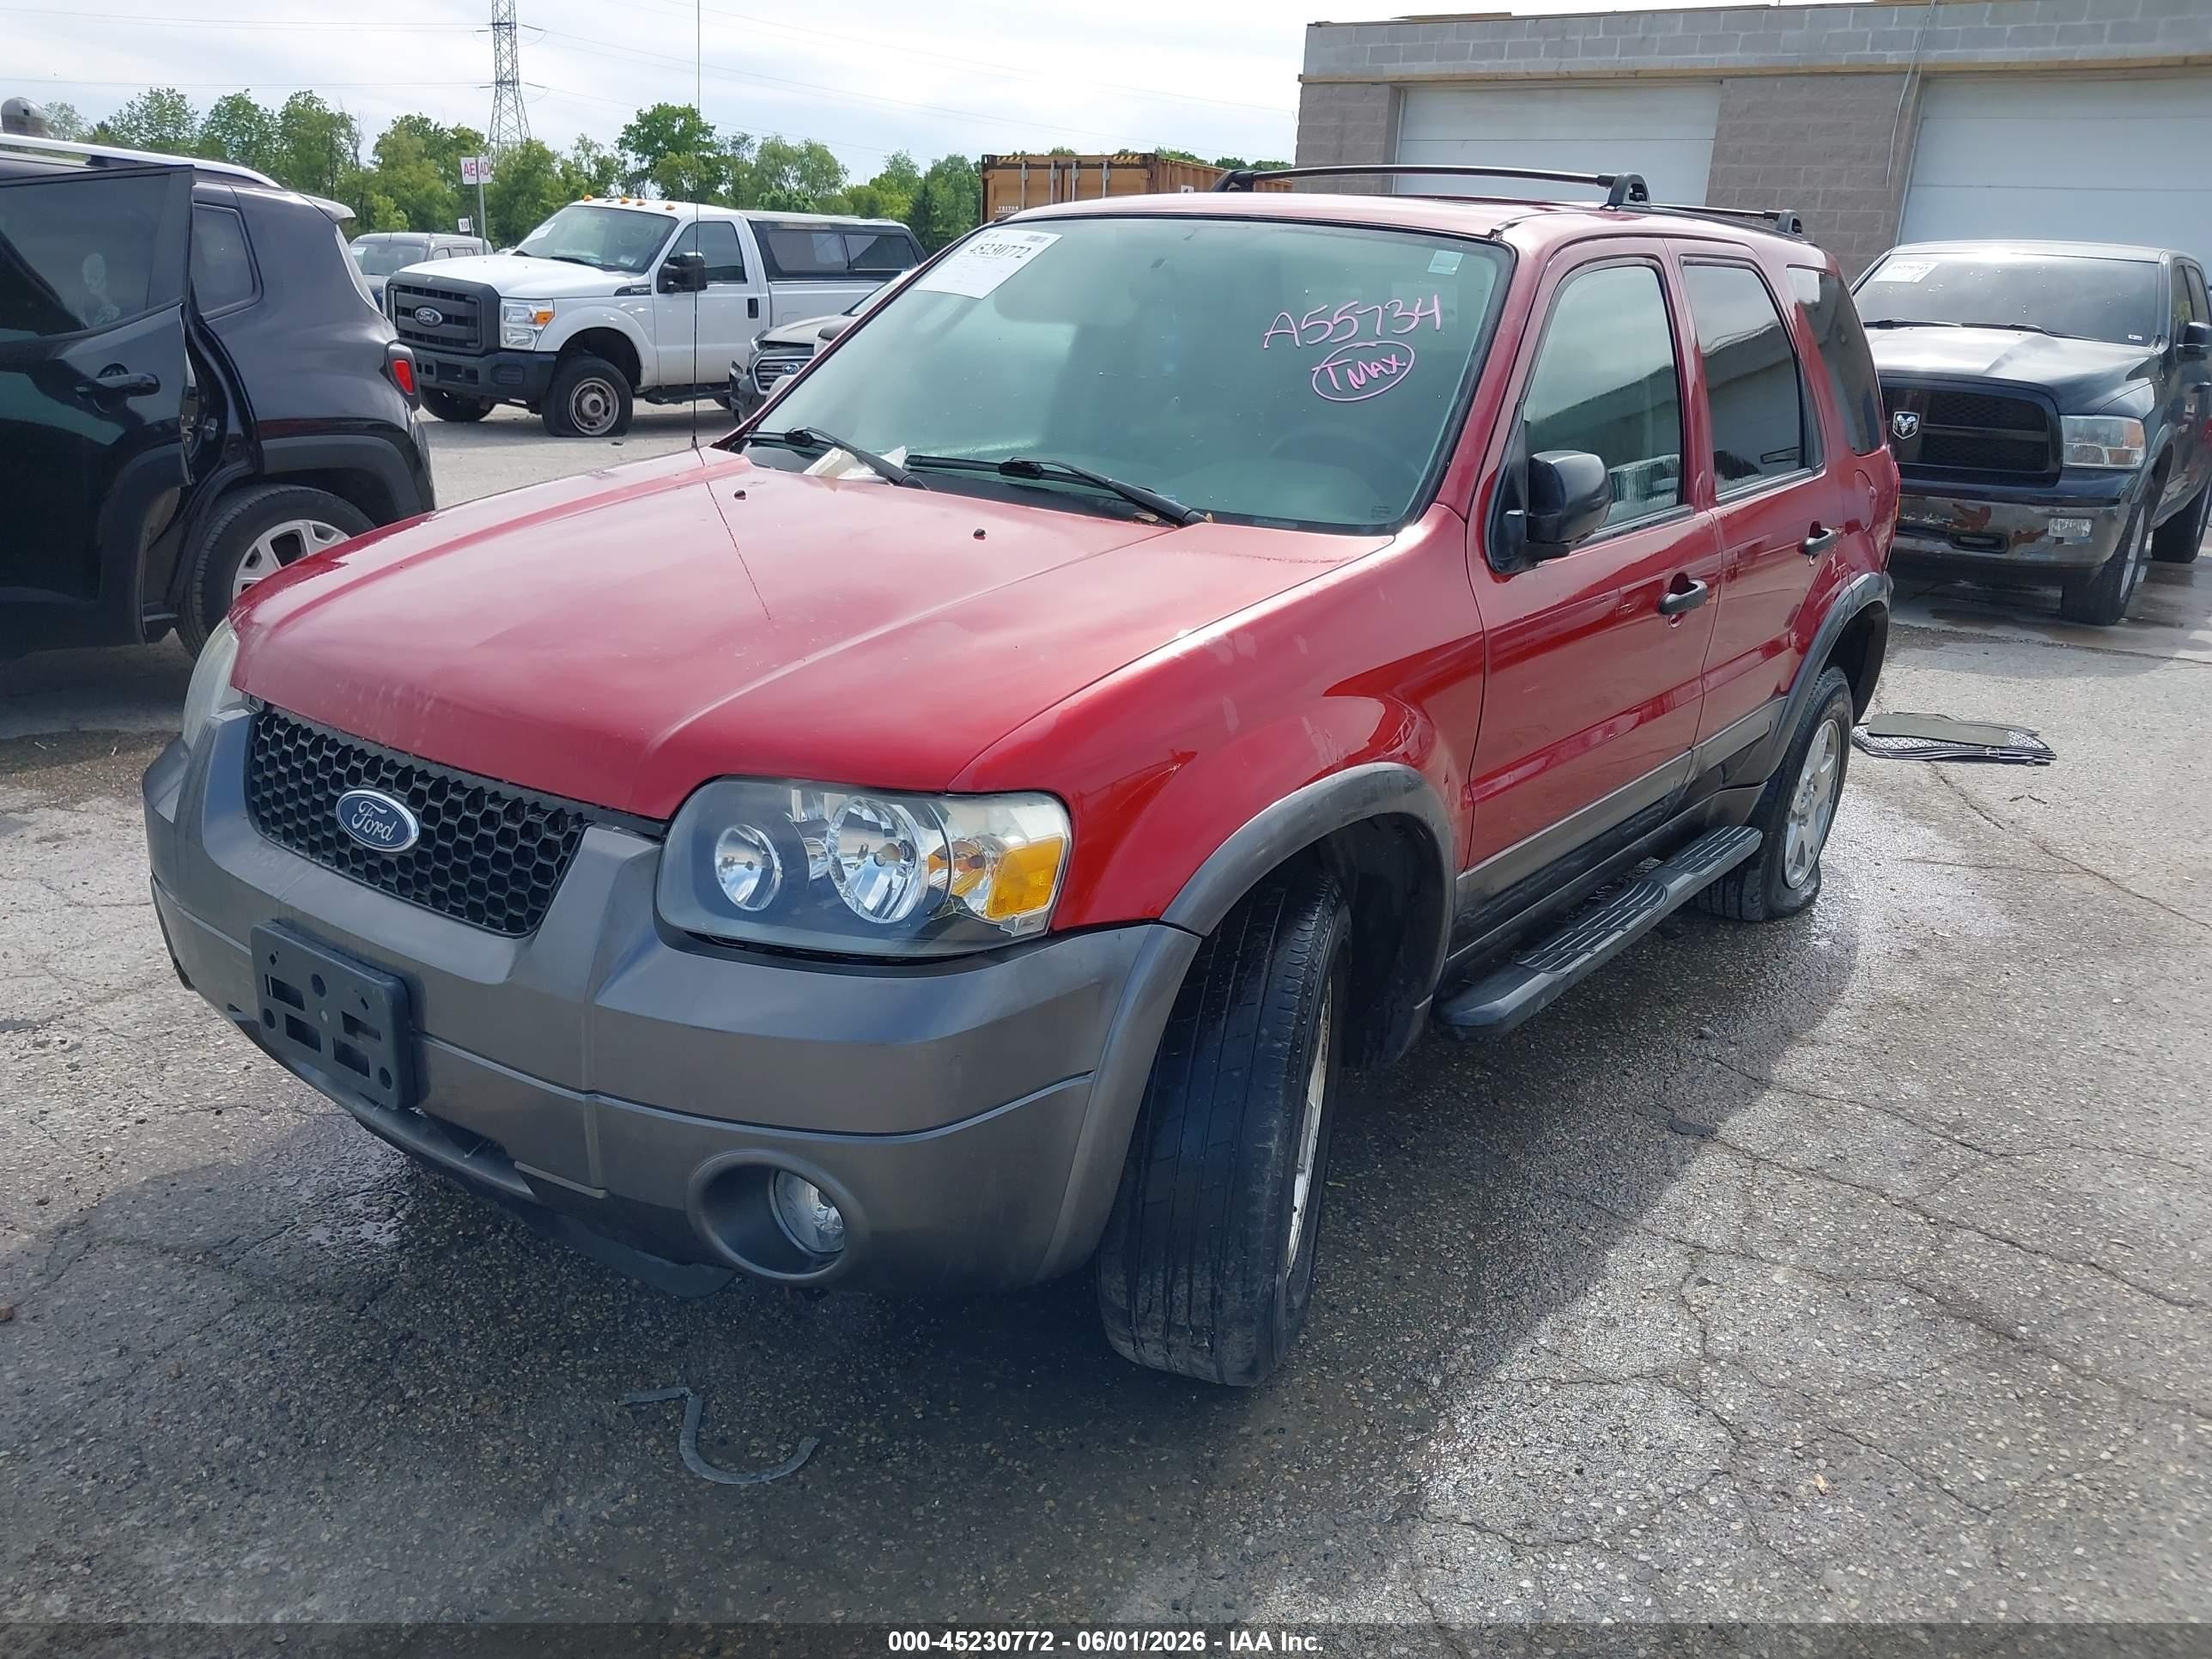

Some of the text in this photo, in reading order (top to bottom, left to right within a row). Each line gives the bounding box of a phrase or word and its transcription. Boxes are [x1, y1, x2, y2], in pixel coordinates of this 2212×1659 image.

[464, 162, 476, 177] AE
[479, 161, 489, 176] AD
[460, 221, 469, 230] 10
[1263, 294, 1442, 349] A55734
[351, 800, 398, 842] Ford
